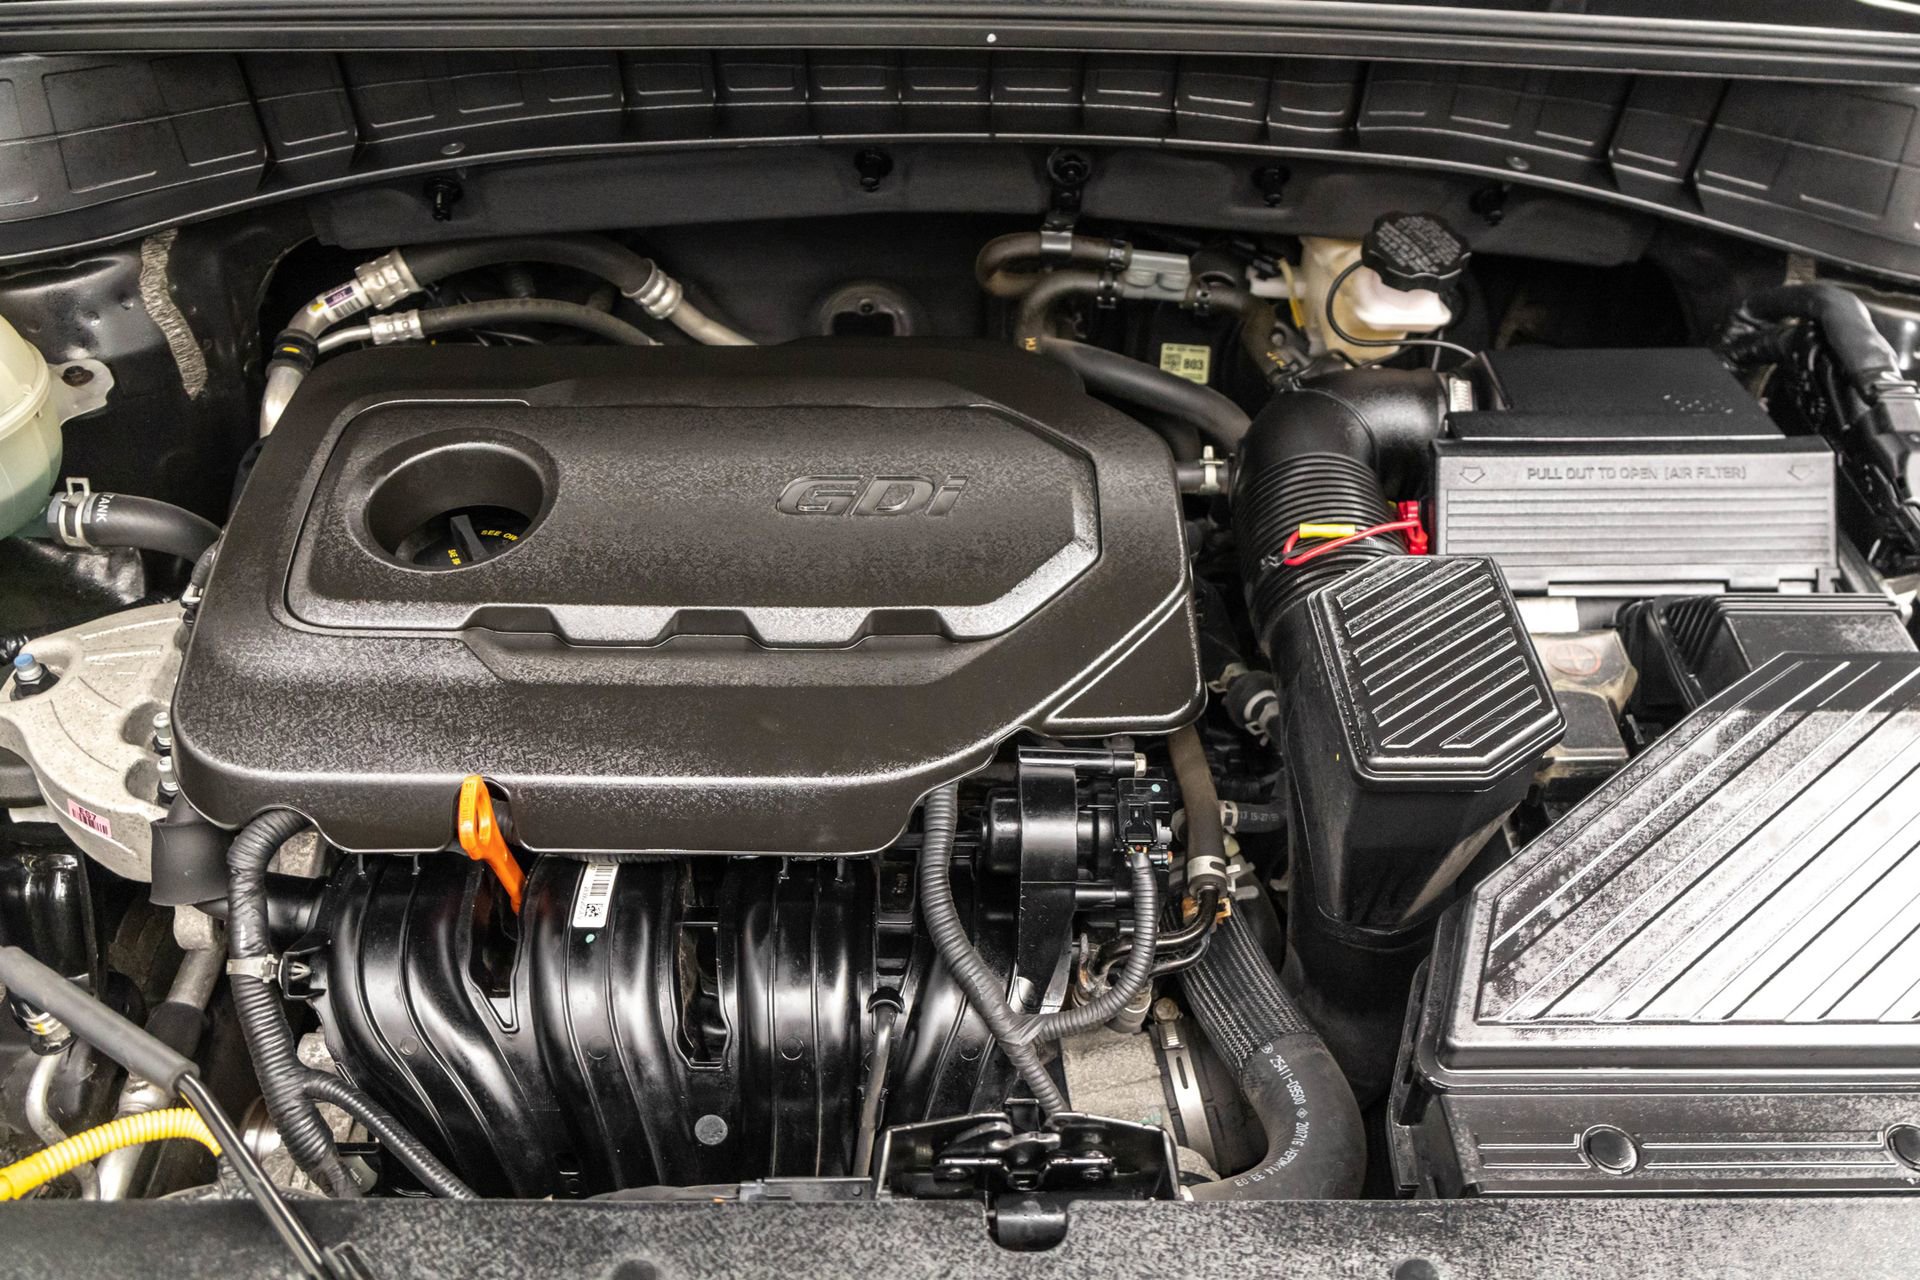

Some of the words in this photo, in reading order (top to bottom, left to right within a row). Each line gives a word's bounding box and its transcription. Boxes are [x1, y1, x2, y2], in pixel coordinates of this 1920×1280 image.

[1527, 466, 1563, 480] PULL
[1566, 466, 1595, 480] OUT
[1597, 466, 1616, 480] TO
[1619, 466, 1657, 480] OPEN
[95, 493, 114, 523] TANK
[776, 474, 969, 516] GDi
